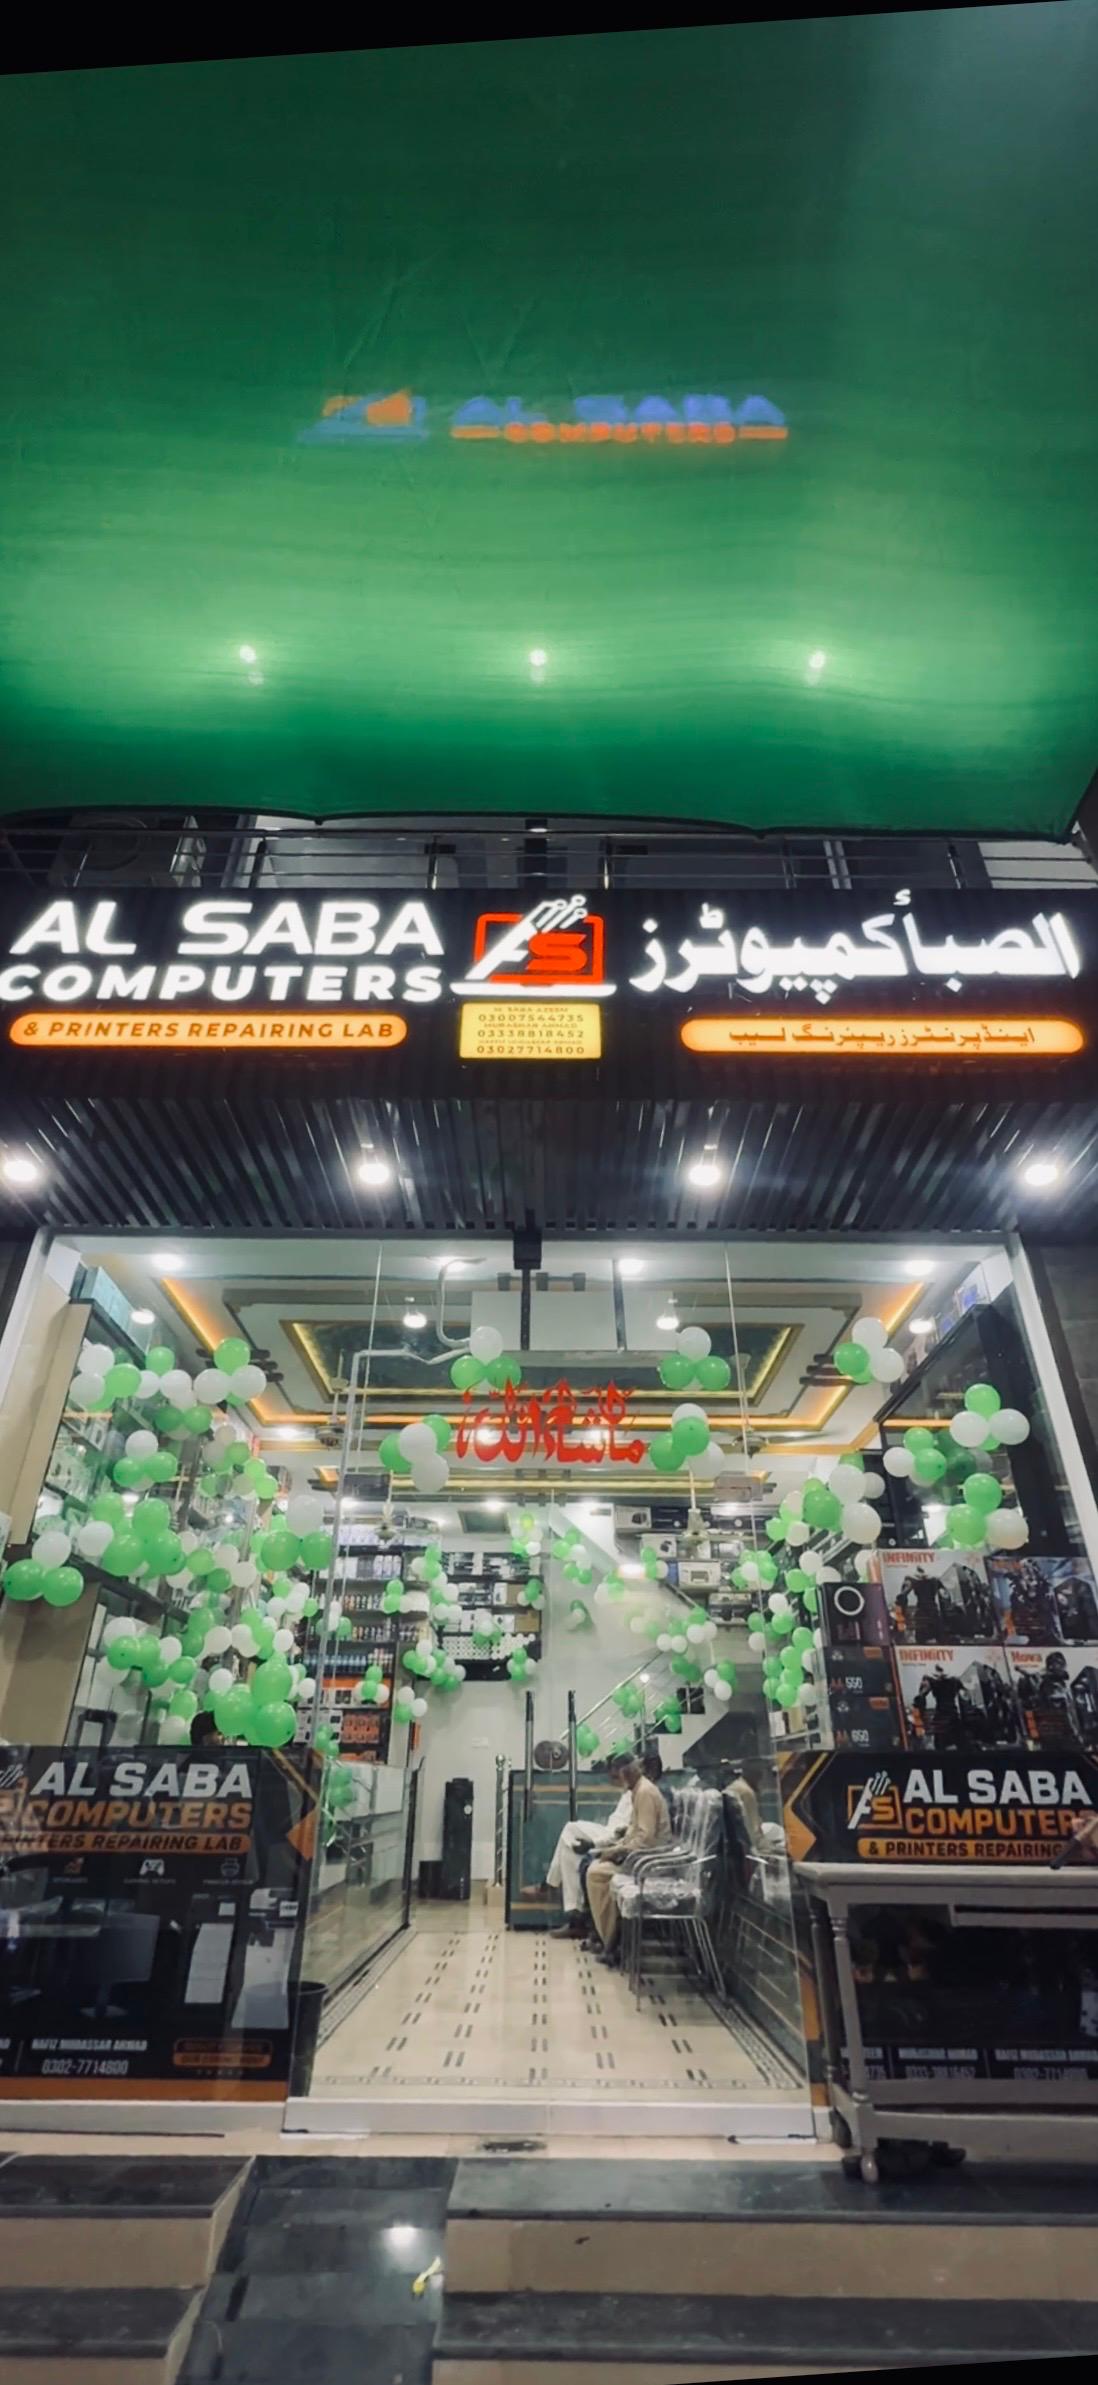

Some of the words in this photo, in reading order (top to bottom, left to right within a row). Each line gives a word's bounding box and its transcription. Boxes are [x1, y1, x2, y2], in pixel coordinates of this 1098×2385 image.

[9, 900, 137, 955] AL
[178, 900, 445, 955] SABA
[0, 965, 444, 1002] COMPUTERS
[24, 1022, 38, 1037] &
[48, 1022, 179, 1038] PRINTERS
[188, 1023, 333, 1038] REPAIRING
[343, 1023, 393, 1038] LAB
[476, 1046, 585, 1054] 03027714800
[30, 1762, 97, 1796] AL
[109, 1762, 253, 1799] SABA
[903, 1769, 959, 1804] AL
[967, 1769, 1093, 1806] SABA
[92, 1834, 197, 1850] REPAIRING
[205, 1836, 242, 1851] LAB
[869, 1842, 879, 1856] &
[886, 1841, 967, 1857] PRINTERS
